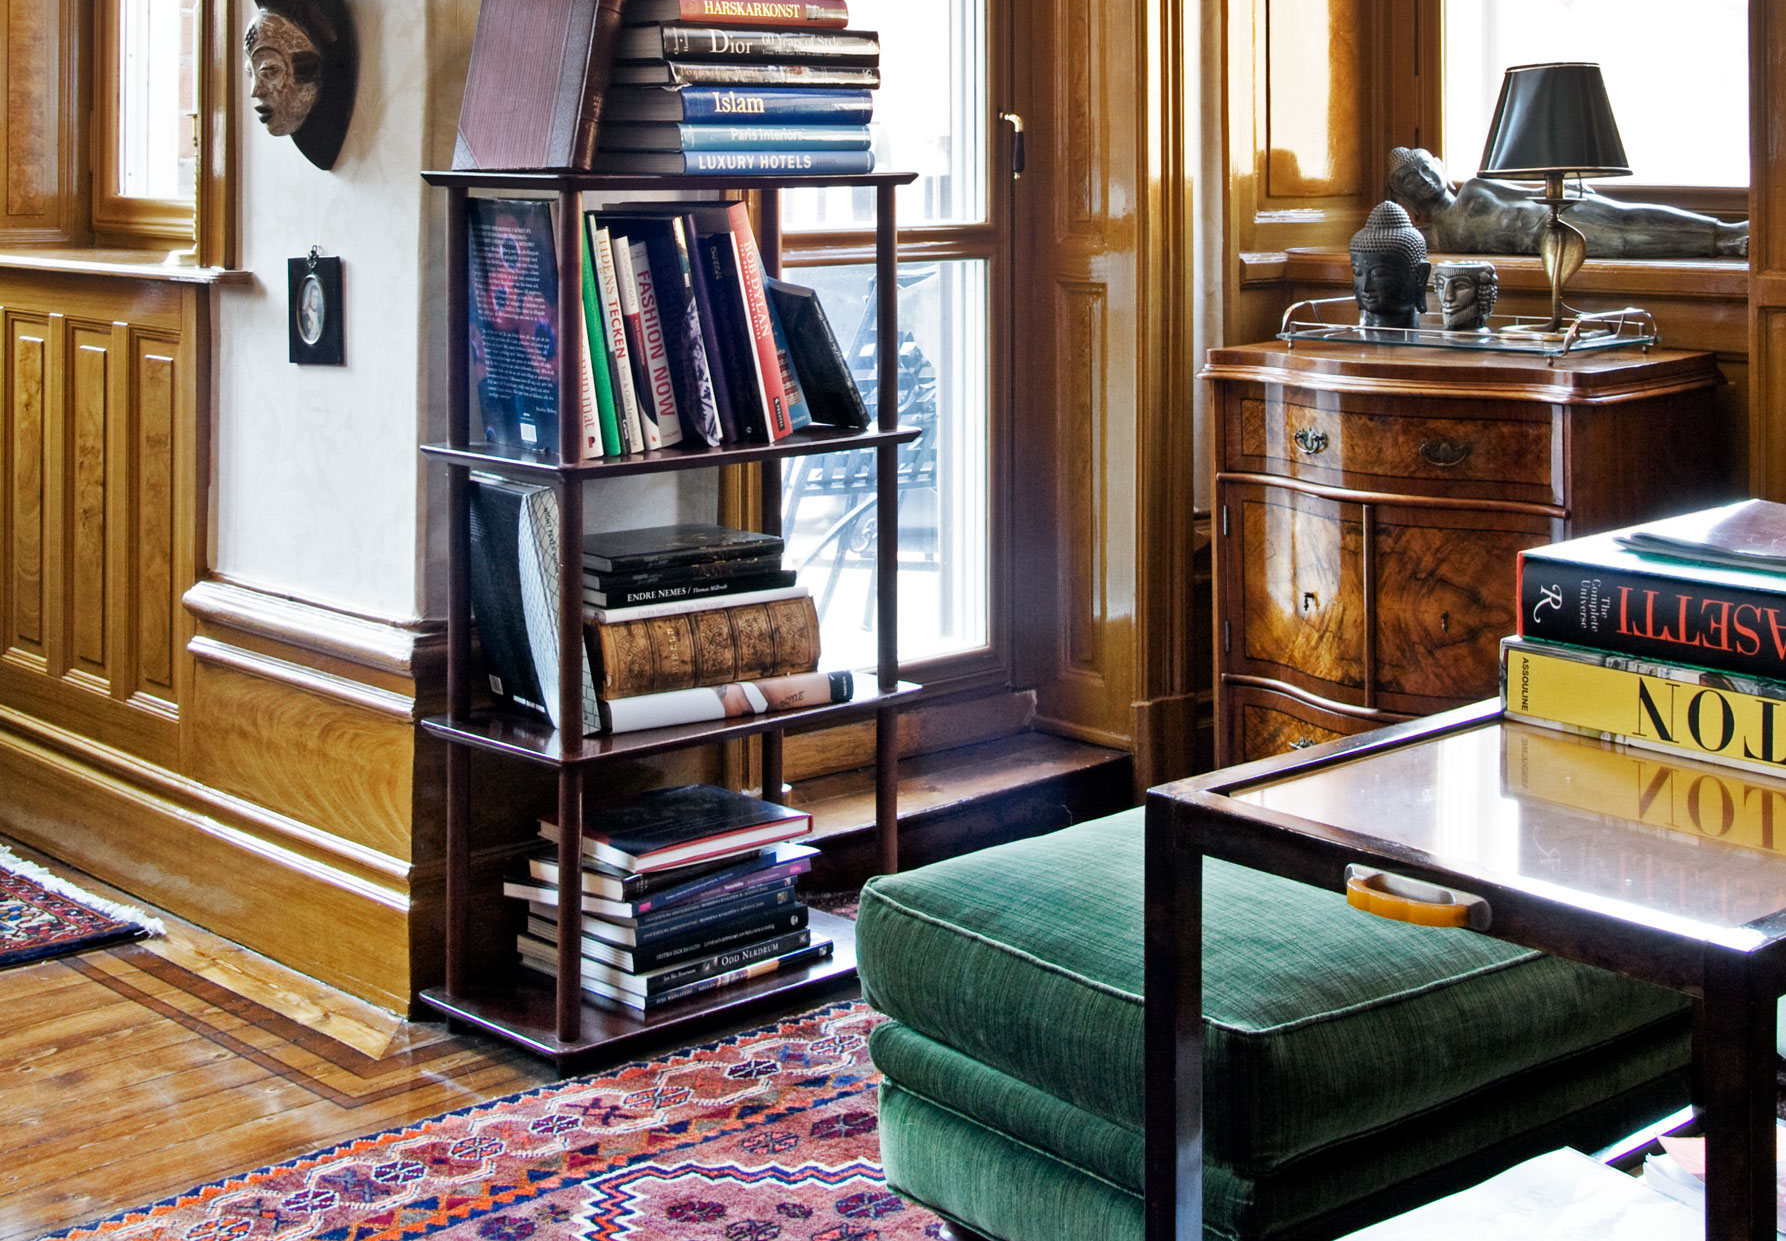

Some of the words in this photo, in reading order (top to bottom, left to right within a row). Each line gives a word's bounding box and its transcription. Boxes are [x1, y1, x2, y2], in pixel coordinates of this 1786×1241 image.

[709, 29, 753, 54] Dior
[762, 34, 774, 45] 60
[776, 33, 800, 48] Years
[803, 34, 815, 46] of
[818, 35, 842, 48] Style
[712, 91, 765, 113] Islam
[731, 128, 757, 141] Paris
[759, 128, 803, 141] Interiors
[698, 155, 754, 170] LUXURY
[760, 155, 812, 169] HOTELS
[599, 240, 615, 295] TIDENS
[608, 298, 626, 359] TECKEN
[744, 241, 757, 274] BOB
[751, 279, 770, 337] DYLAN
[637, 269, 664, 360] FASHION
[653, 366, 675, 416] NOW
[627, 590, 657, 602] ENDRE
[658, 587, 687, 598] NEMES
[1533, 584, 1563, 624] R
[1580, 579, 1591, 629] Universe
[1590, 579, 1602, 633] Complete
[1600, 596, 1611, 619] The
[1521, 657, 1530, 712] ASSOULINE
[1632, 677, 1786, 765] TON
[721, 956, 740, 967] ODD
[742, 943, 779, 960] NERDRUM
